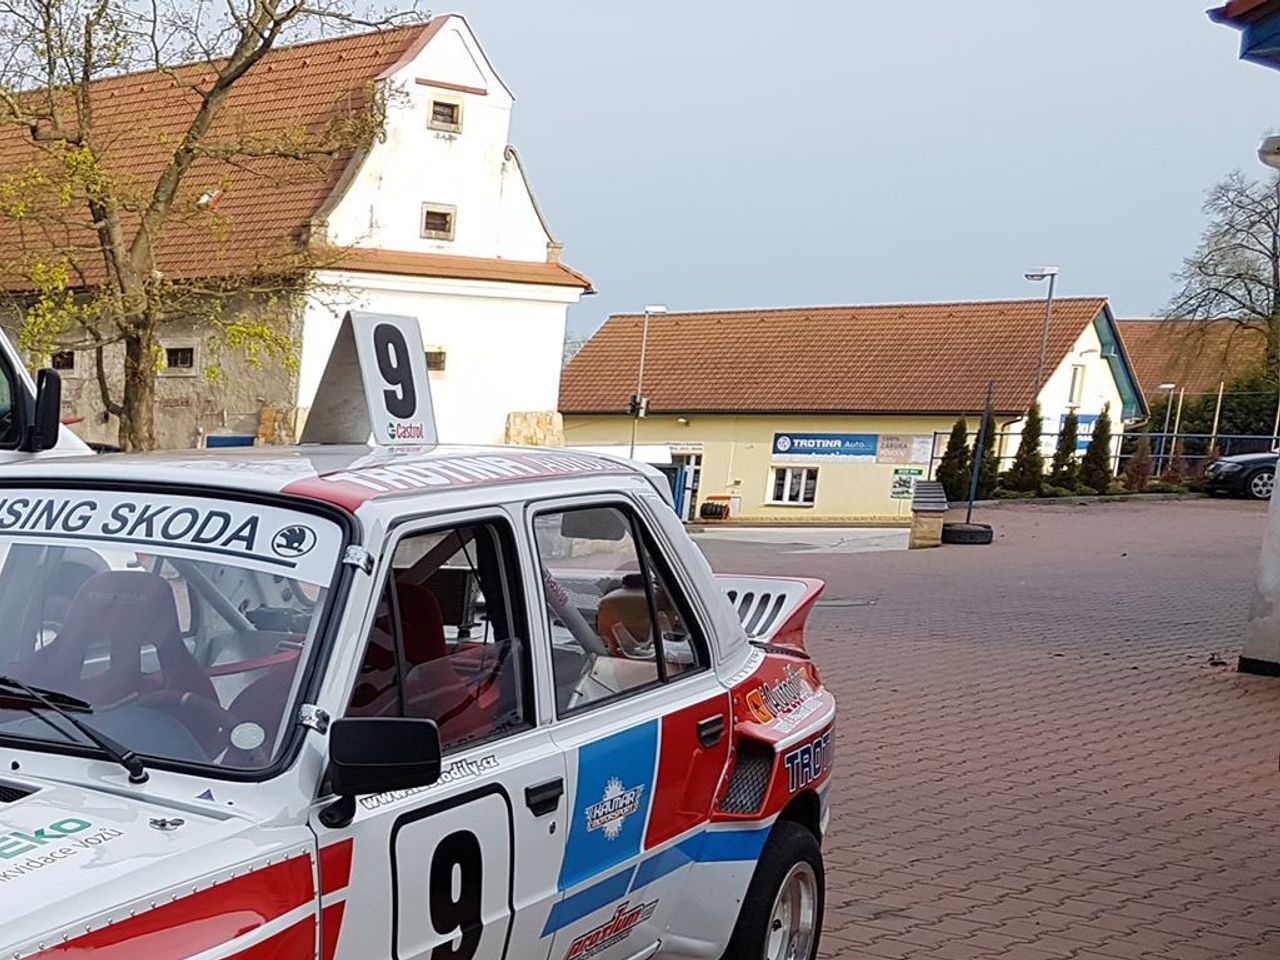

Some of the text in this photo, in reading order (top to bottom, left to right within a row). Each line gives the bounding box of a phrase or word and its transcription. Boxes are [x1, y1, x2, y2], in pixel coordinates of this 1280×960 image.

[373, 323, 417, 420] 9
[396, 423, 424, 440] Castrol
[793, 438, 842, 448] TROTINA
[322, 455, 541, 492] TROTINA
[101, 502, 257, 551] SKODA
[73, 827, 124, 850] vozů
